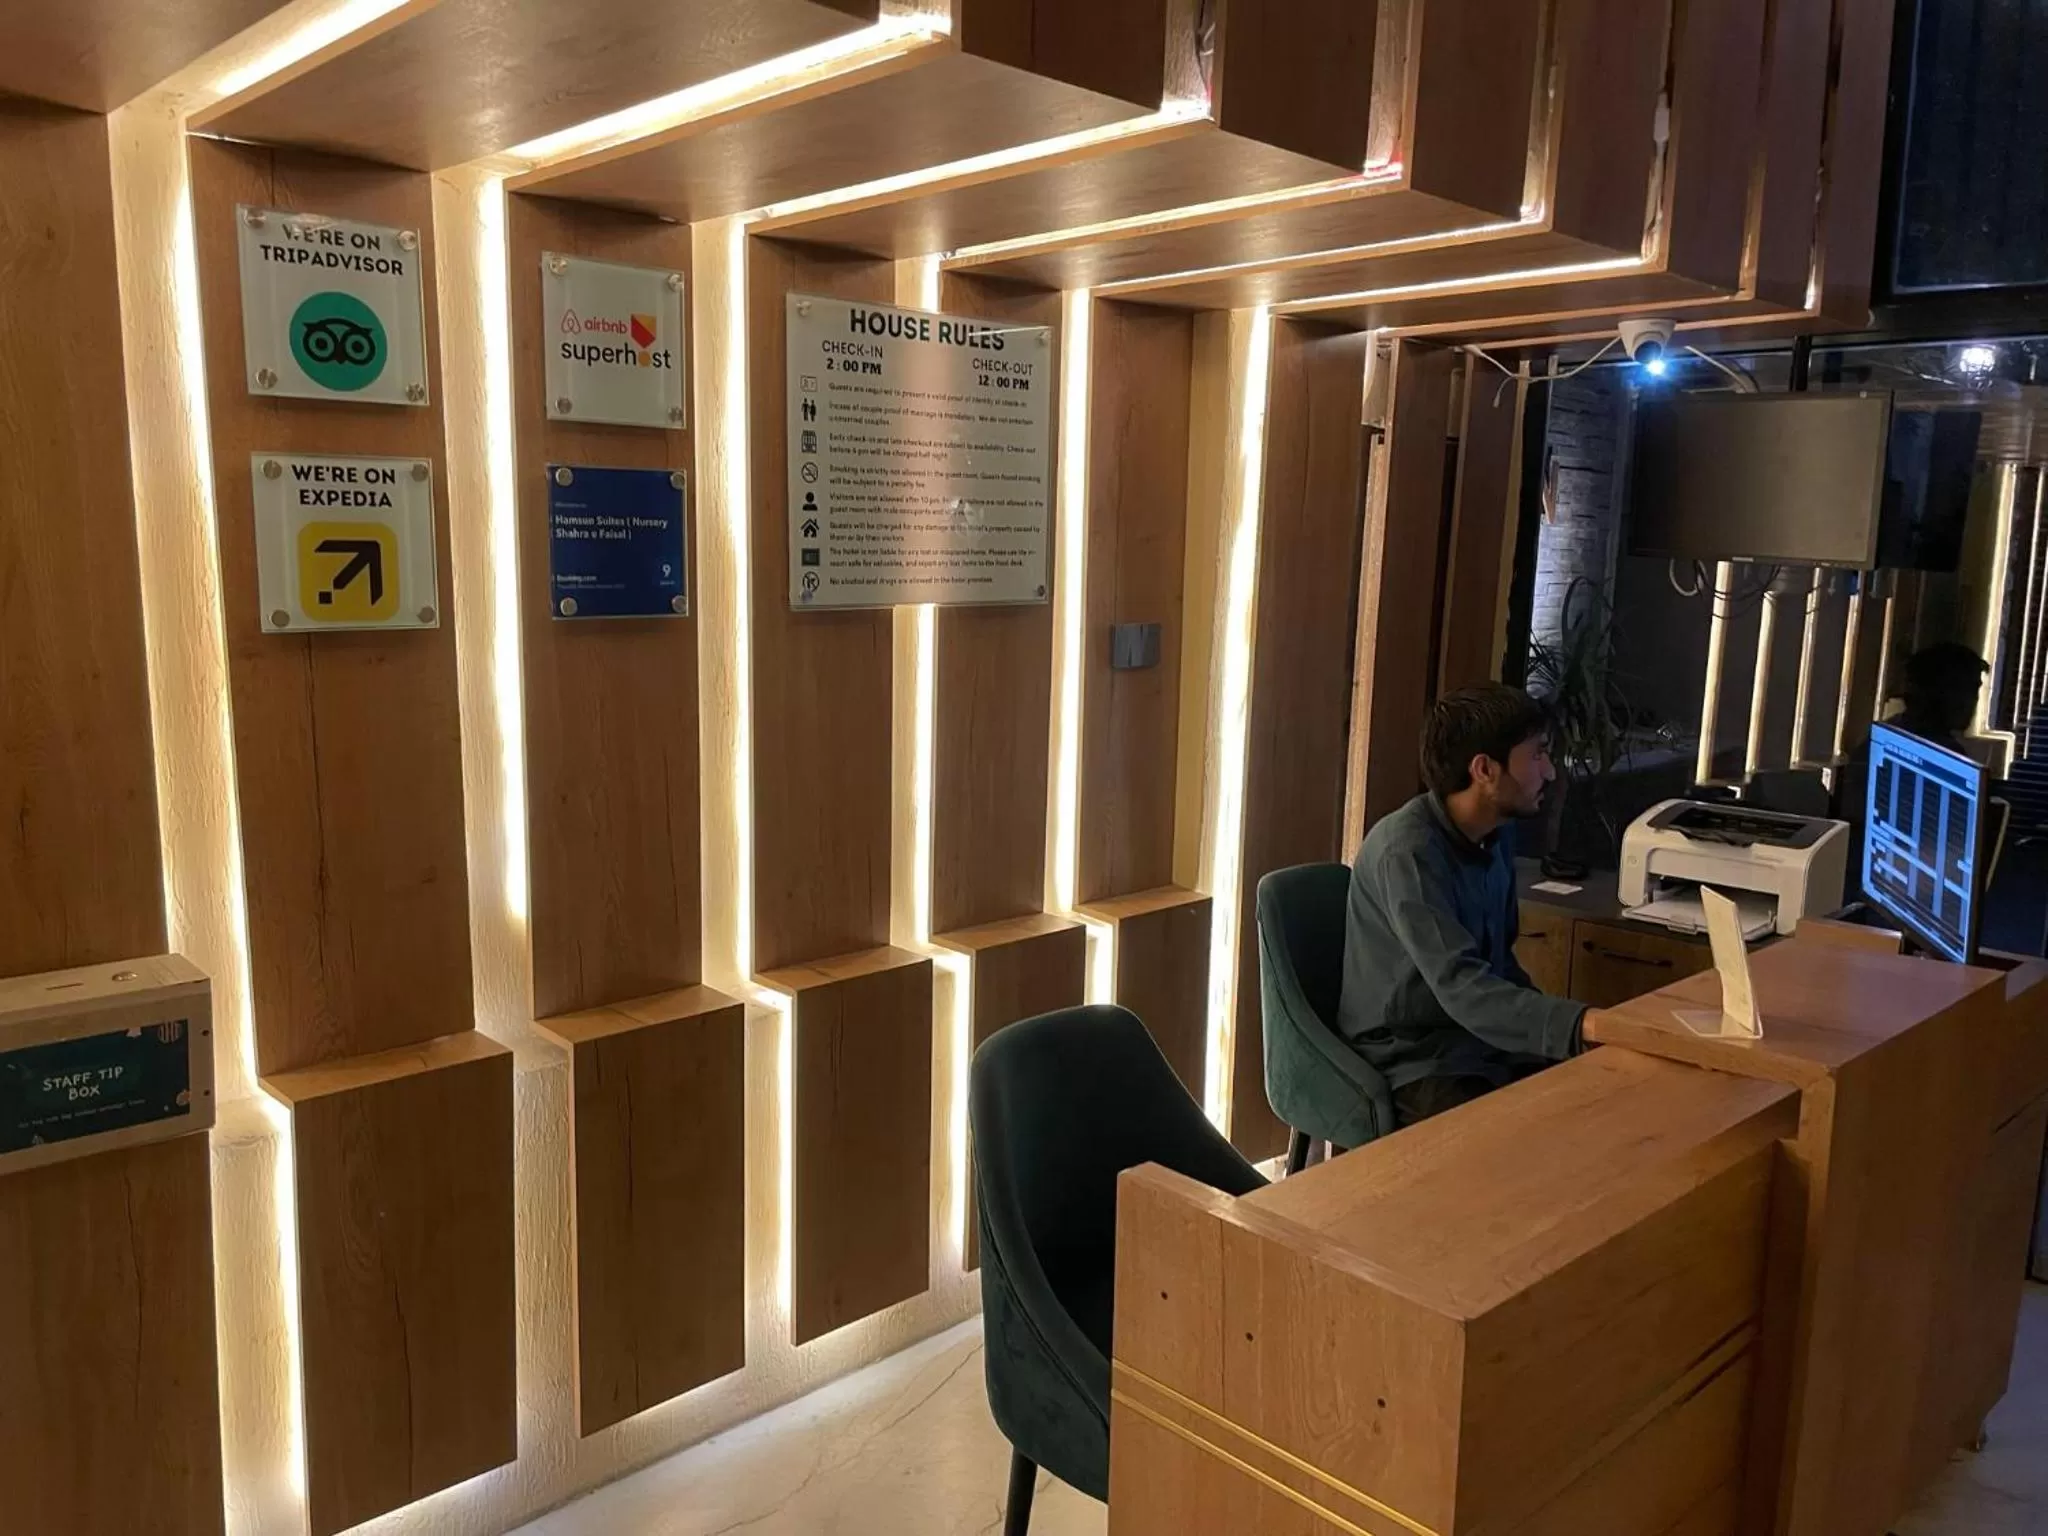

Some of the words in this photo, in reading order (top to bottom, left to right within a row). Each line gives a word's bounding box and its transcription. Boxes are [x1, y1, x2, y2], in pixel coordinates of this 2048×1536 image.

[282, 223, 344, 246] WE'RE
[351, 233, 380, 250] ON
[260, 244, 403, 275] TRIPADVISOR
[584, 316, 628, 335] airbnb
[850, 308, 930, 342] HOUSE
[938, 320, 1005, 351] RULES
[822, 339, 883, 360] CHECK-IN
[862, 361, 882, 375] PM
[972, 358, 1034, 377] CHECK-OUT
[1012, 378, 1030, 391] PM
[291, 464, 358, 483] WE'RE
[364, 468, 396, 484] ON
[299, 489, 393, 508] EXPEDIA
[632, 517, 668, 530] Nursery
[555, 528, 589, 539] Shahra
[598, 529, 626, 540] Faisal
[662, 563, 672, 578] 9
[43, 1071, 92, 1092] STAFF
[98, 1066, 124, 1082] TIP
[68, 1085, 102, 1101] BOX
